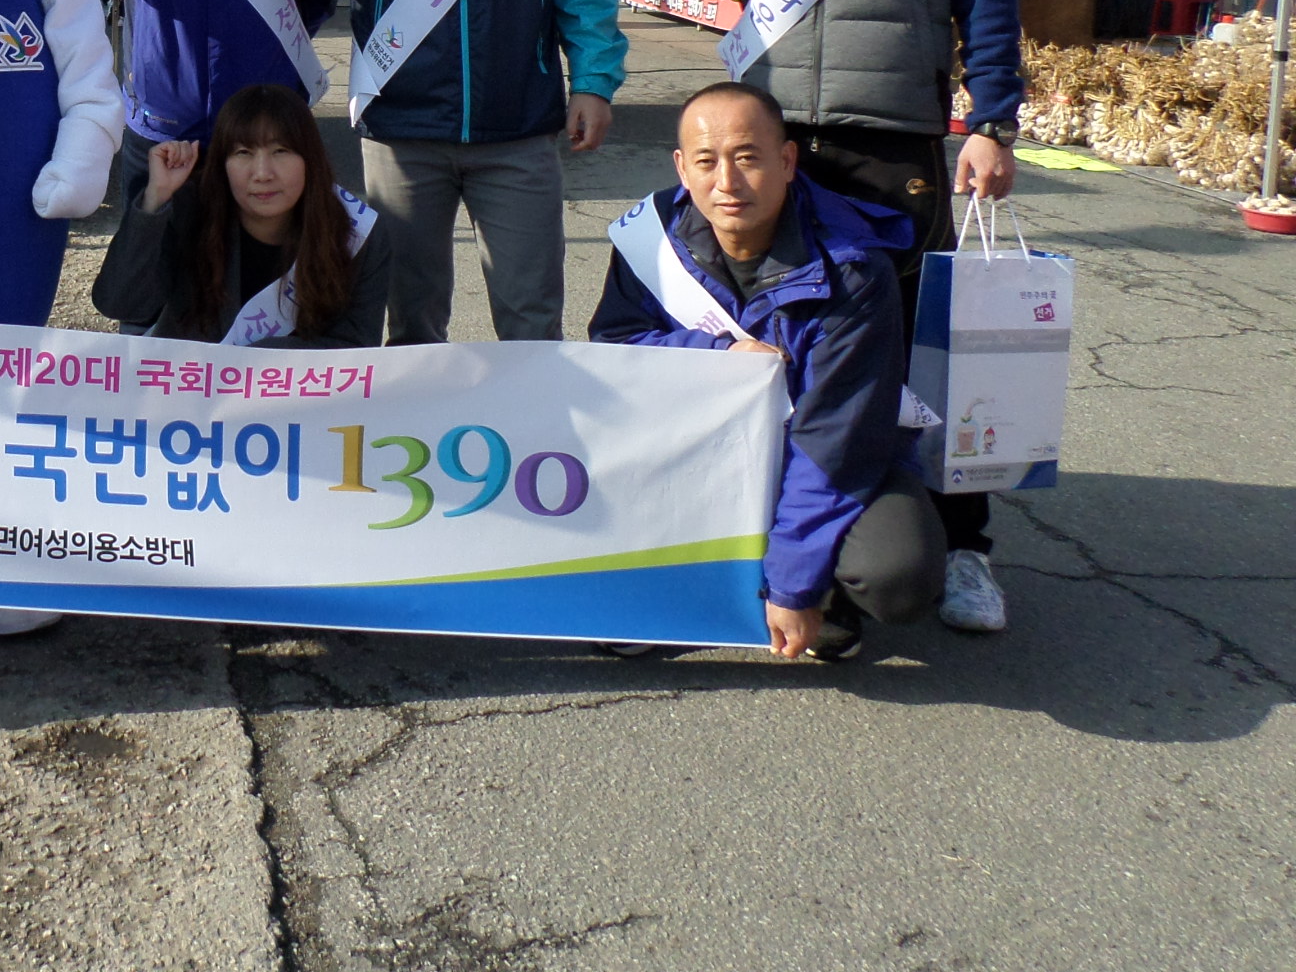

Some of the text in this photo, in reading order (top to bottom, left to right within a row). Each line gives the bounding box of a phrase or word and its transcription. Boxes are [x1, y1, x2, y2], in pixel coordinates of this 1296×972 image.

[136, 360, 374, 399] 국회의원선거
[5, 414, 301, 514] 국번없이
[328, 424, 590, 530] 1390
